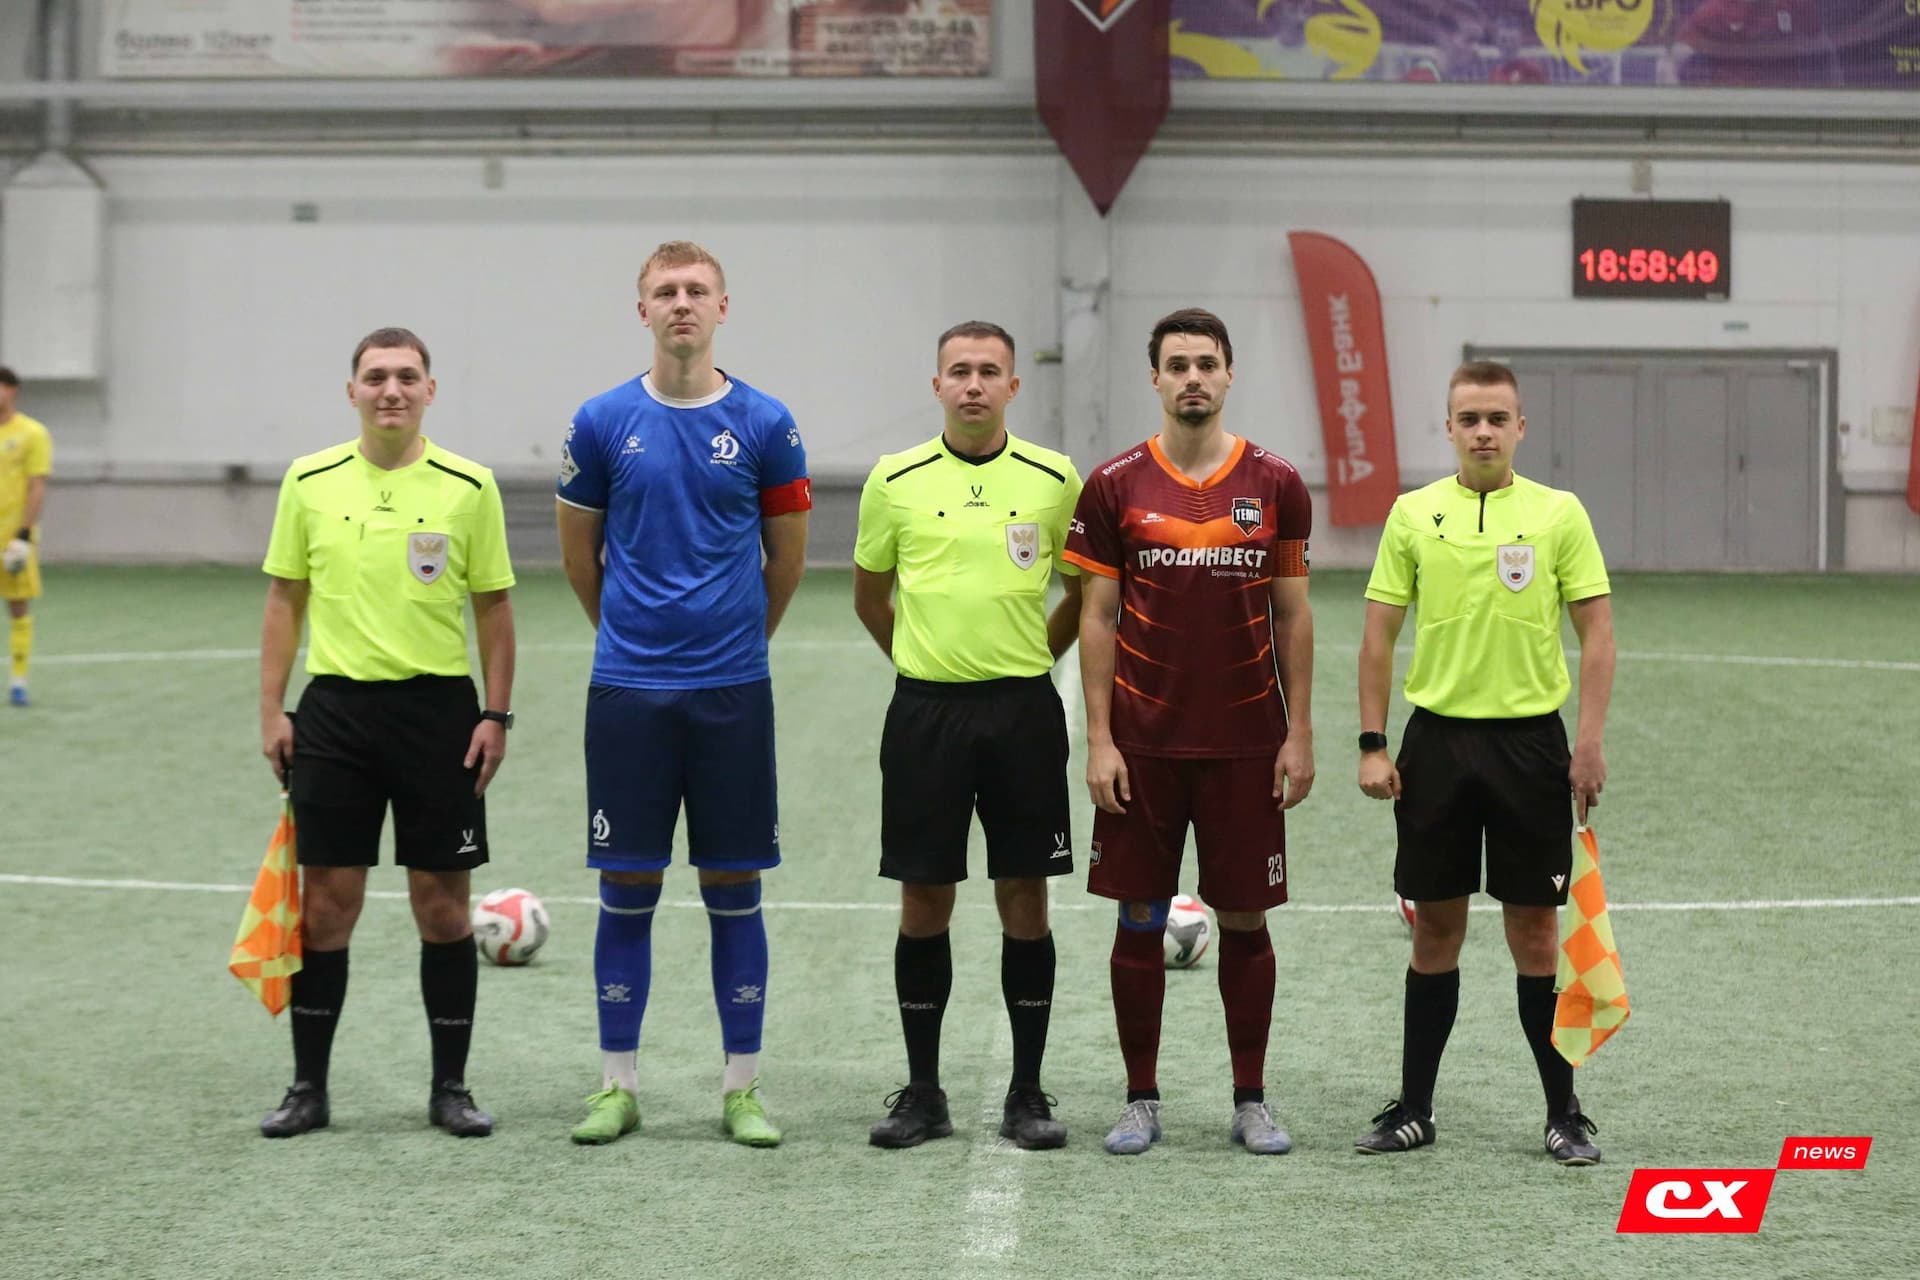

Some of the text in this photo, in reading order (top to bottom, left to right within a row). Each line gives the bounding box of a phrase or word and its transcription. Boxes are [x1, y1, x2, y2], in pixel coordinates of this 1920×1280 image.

[1579, 248, 1719, 283] 18:58:49
[1235, 508, 1260, 523] ТЕМП
[1137, 547, 1267, 570] ПРОДИНВЕСТ
[1268, 853, 1284, 886] 23
